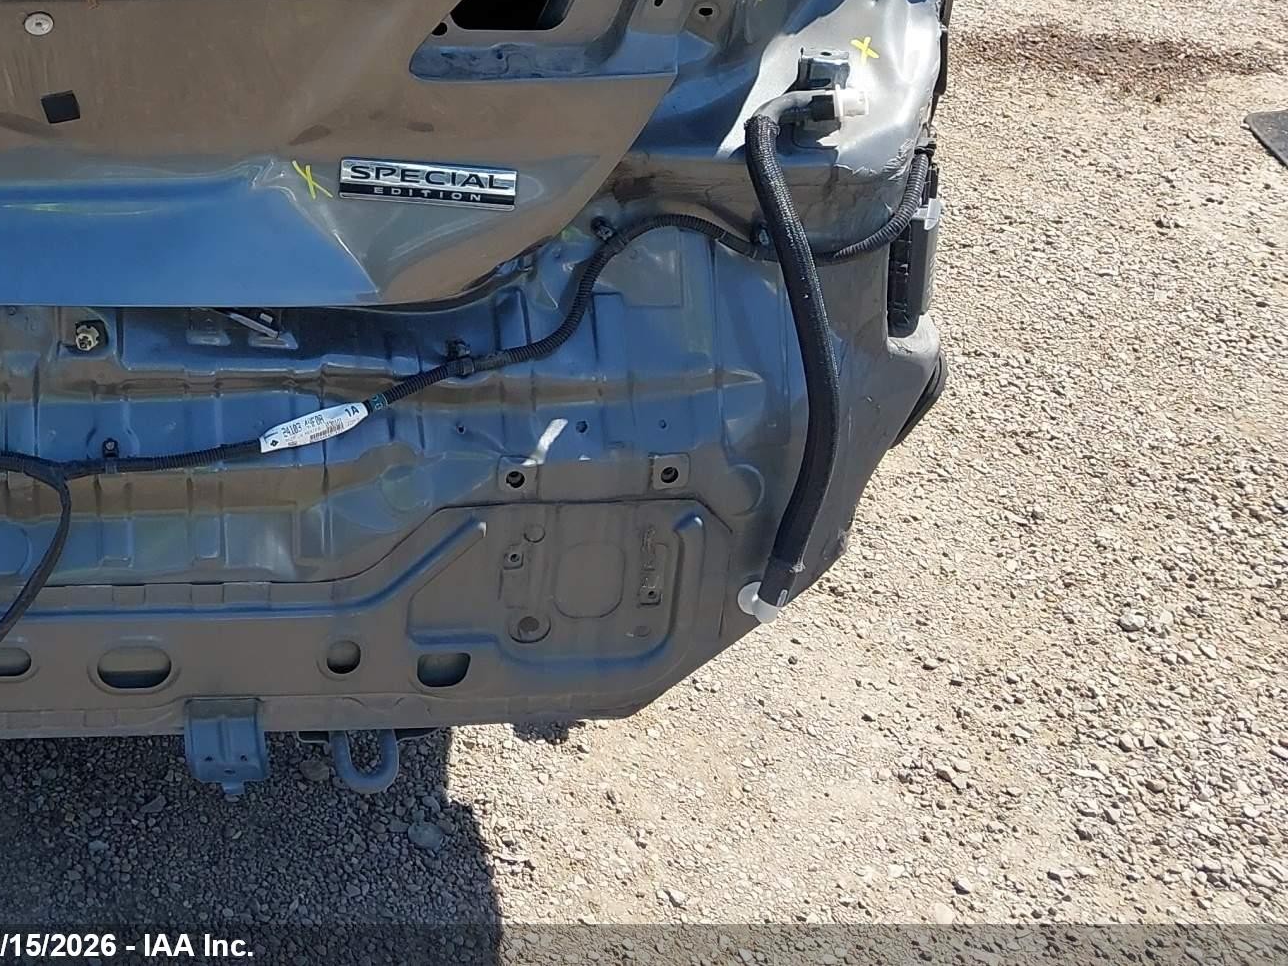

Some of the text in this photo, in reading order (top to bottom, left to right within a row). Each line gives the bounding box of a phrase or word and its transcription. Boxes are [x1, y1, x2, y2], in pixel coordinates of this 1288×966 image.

[350, 165, 511, 191] SPECIAL
[373, 186, 483, 202] EDITION
[344, 405, 360, 418] 1A
